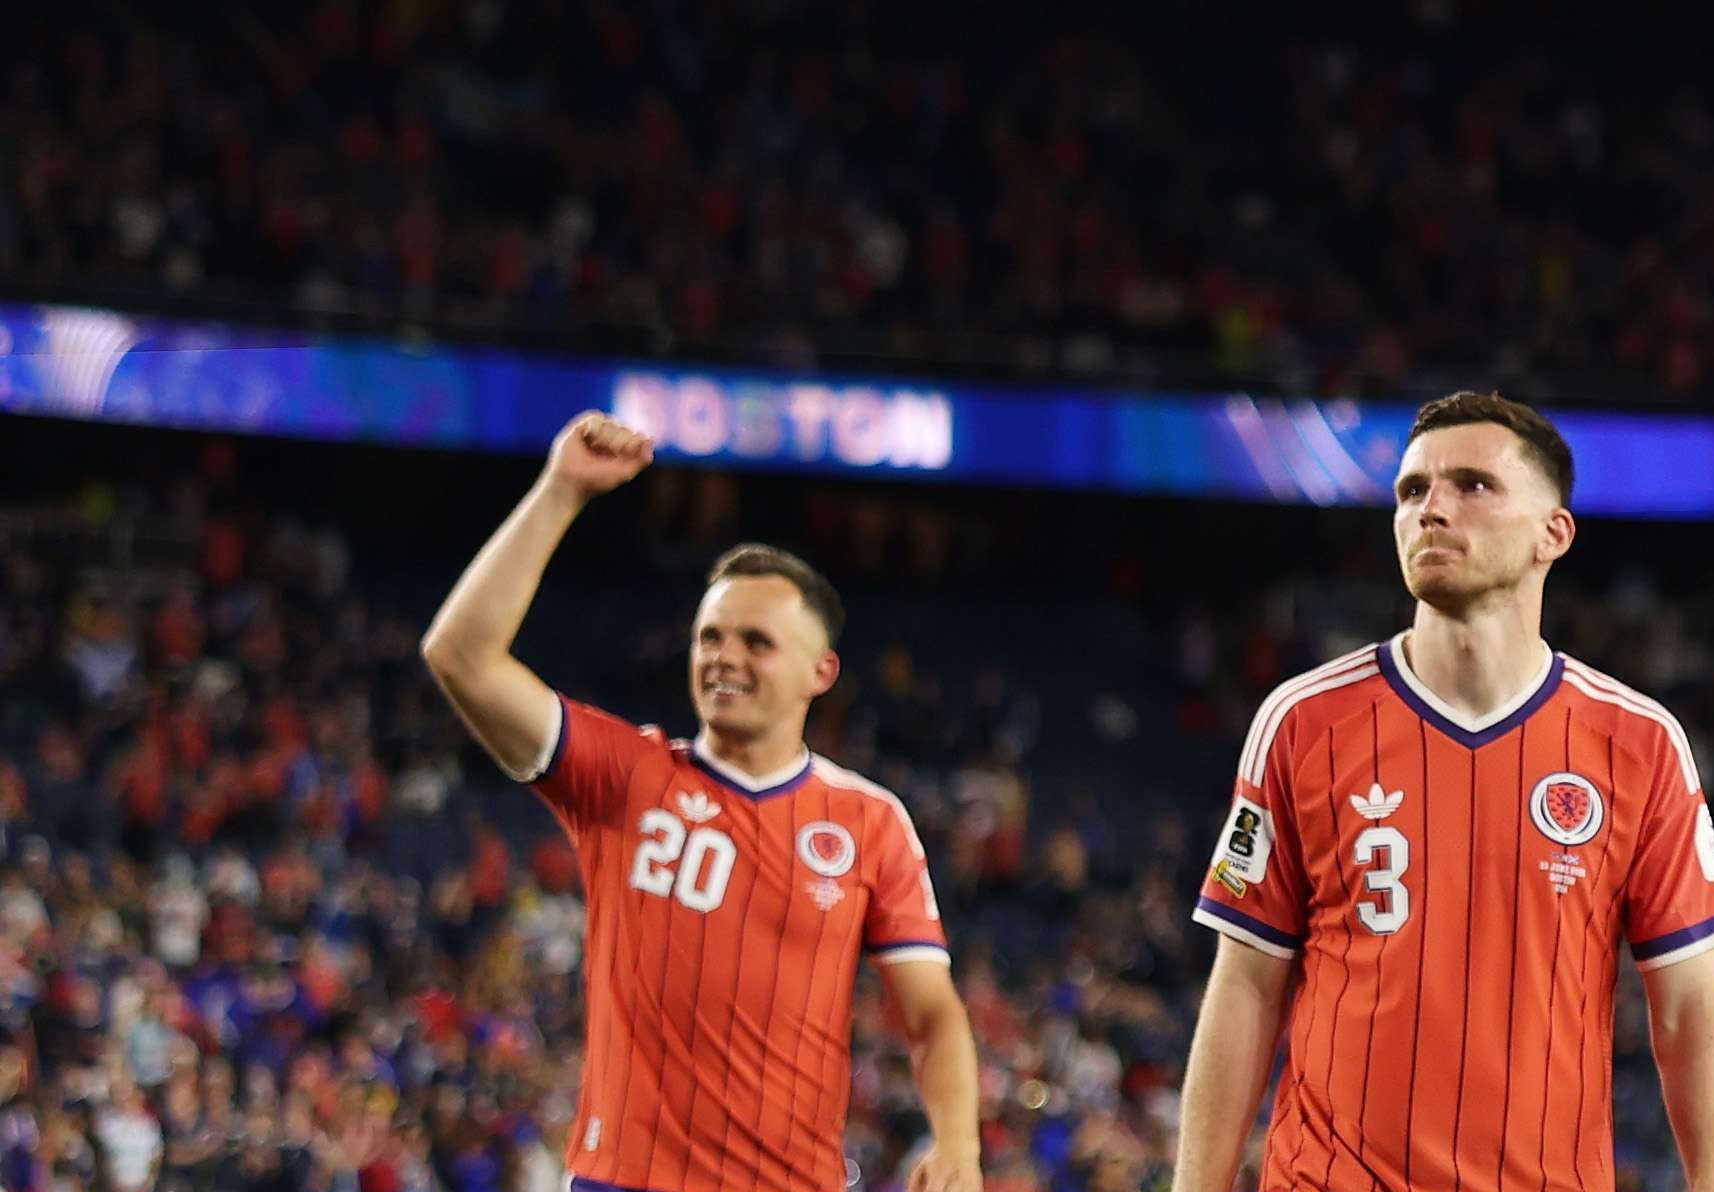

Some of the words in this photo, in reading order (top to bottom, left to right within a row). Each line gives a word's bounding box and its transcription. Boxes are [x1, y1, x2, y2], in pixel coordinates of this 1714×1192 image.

[612, 371, 953, 469] BOSTON
[630, 808, 737, 913] 20
[1354, 827, 1410, 935] 3
